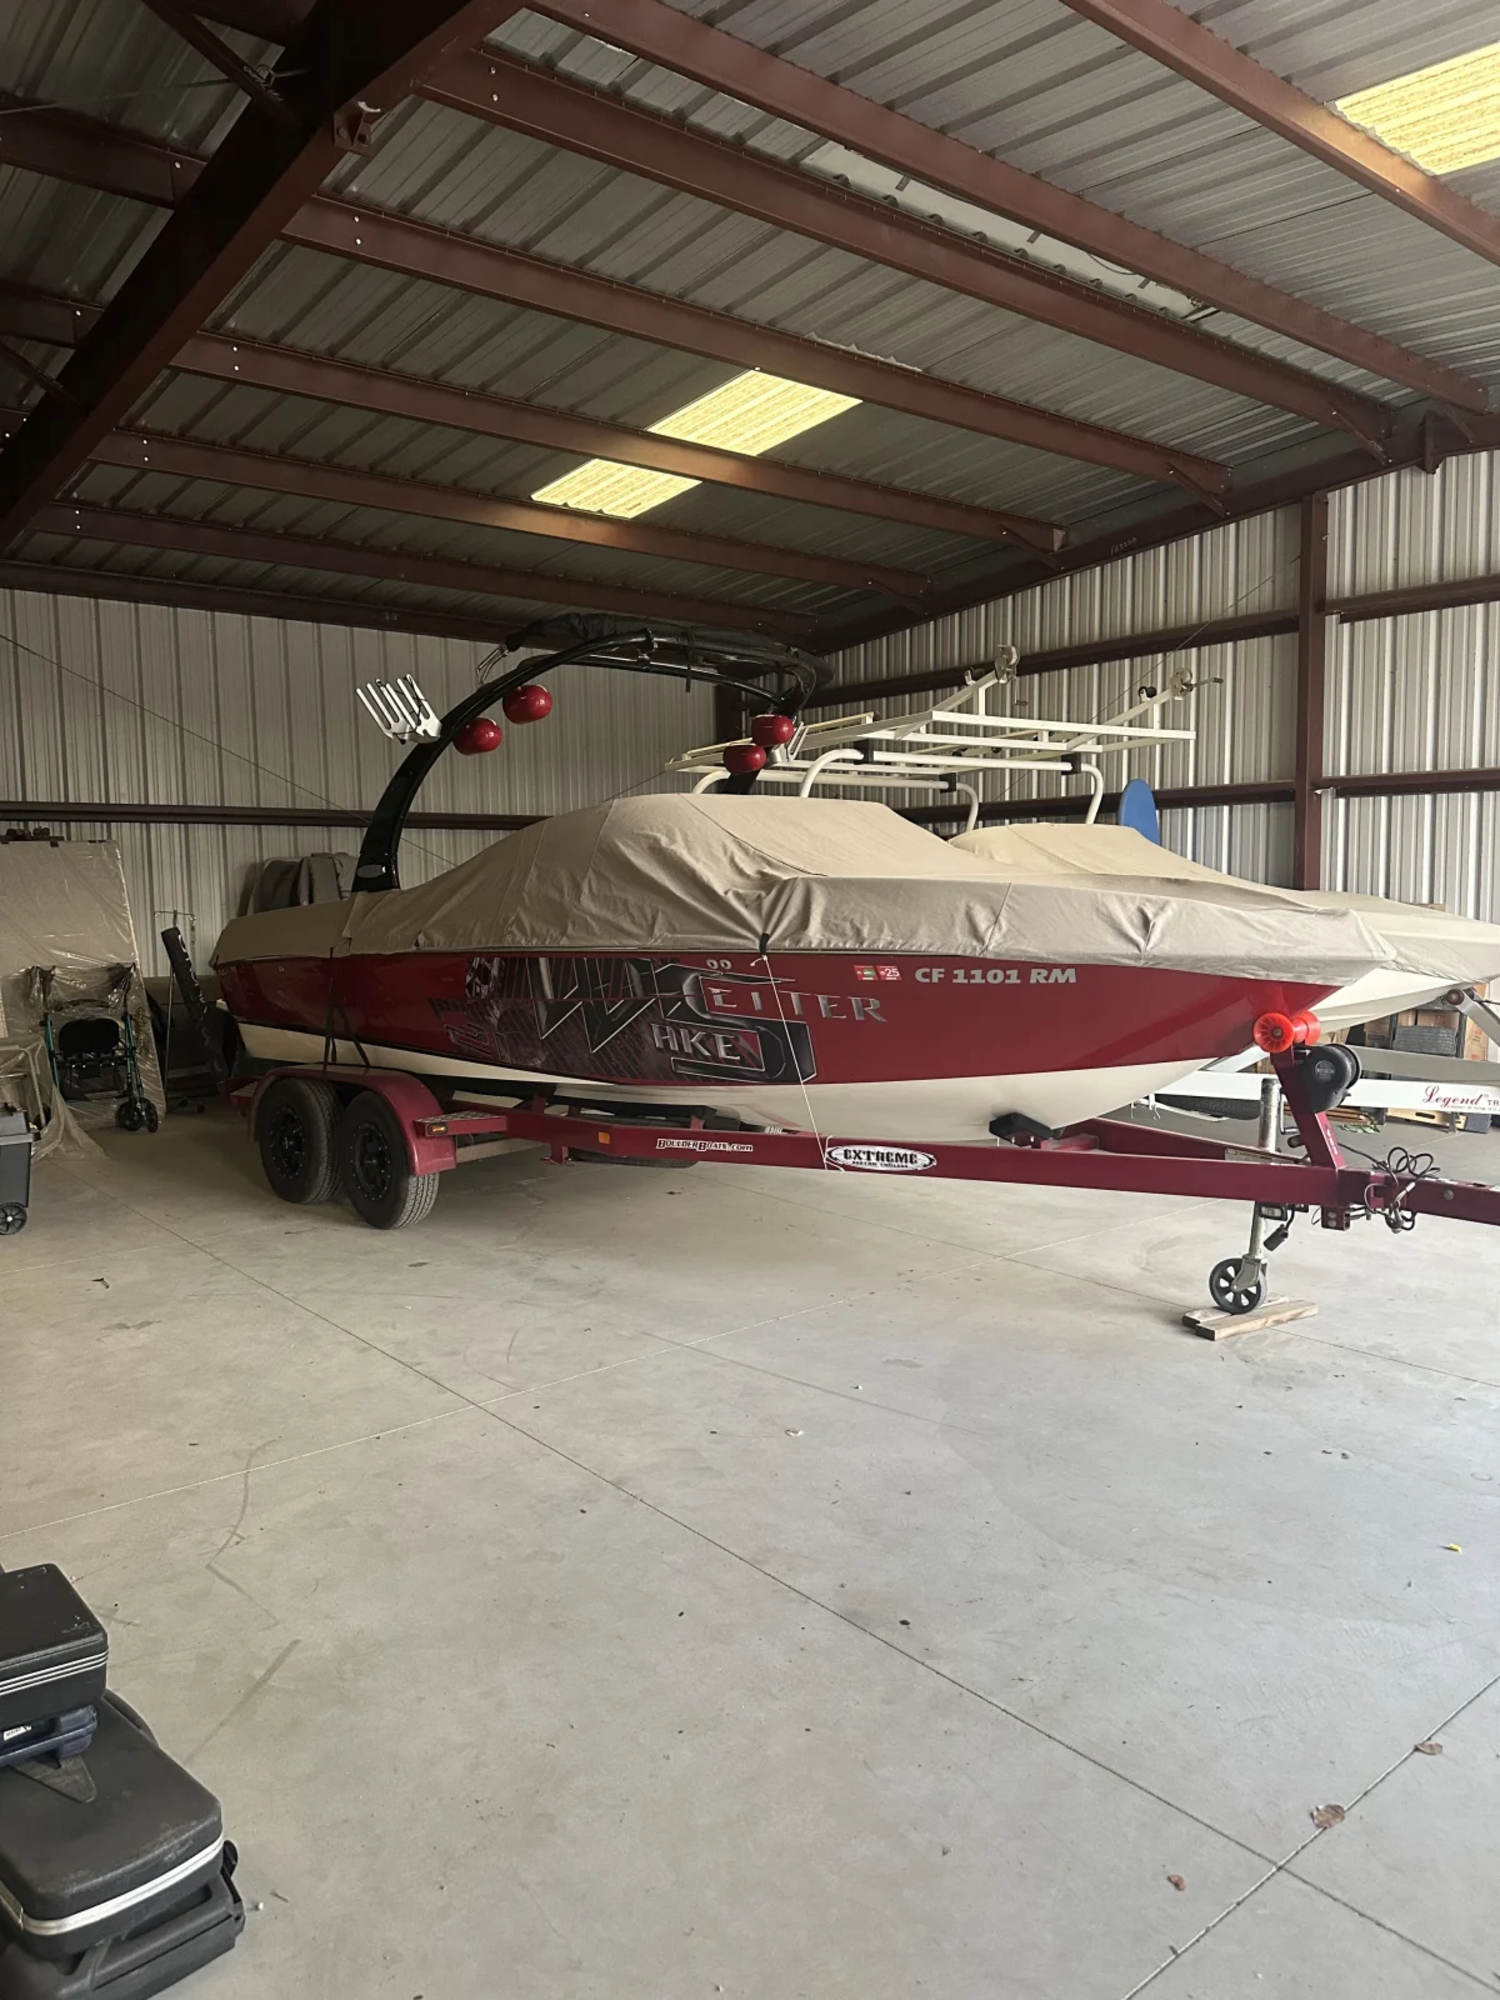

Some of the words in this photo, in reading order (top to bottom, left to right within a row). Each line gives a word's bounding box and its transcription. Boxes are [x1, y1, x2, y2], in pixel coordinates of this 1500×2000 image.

[884, 968, 900, 977] 25
[914, 967, 945, 984] CF
[952, 968, 1021, 985] 1101
[1029, 967, 1077, 984] RM
[1422, 1084, 1484, 1109] Legend
[843, 1148, 918, 1165] EXTREME
